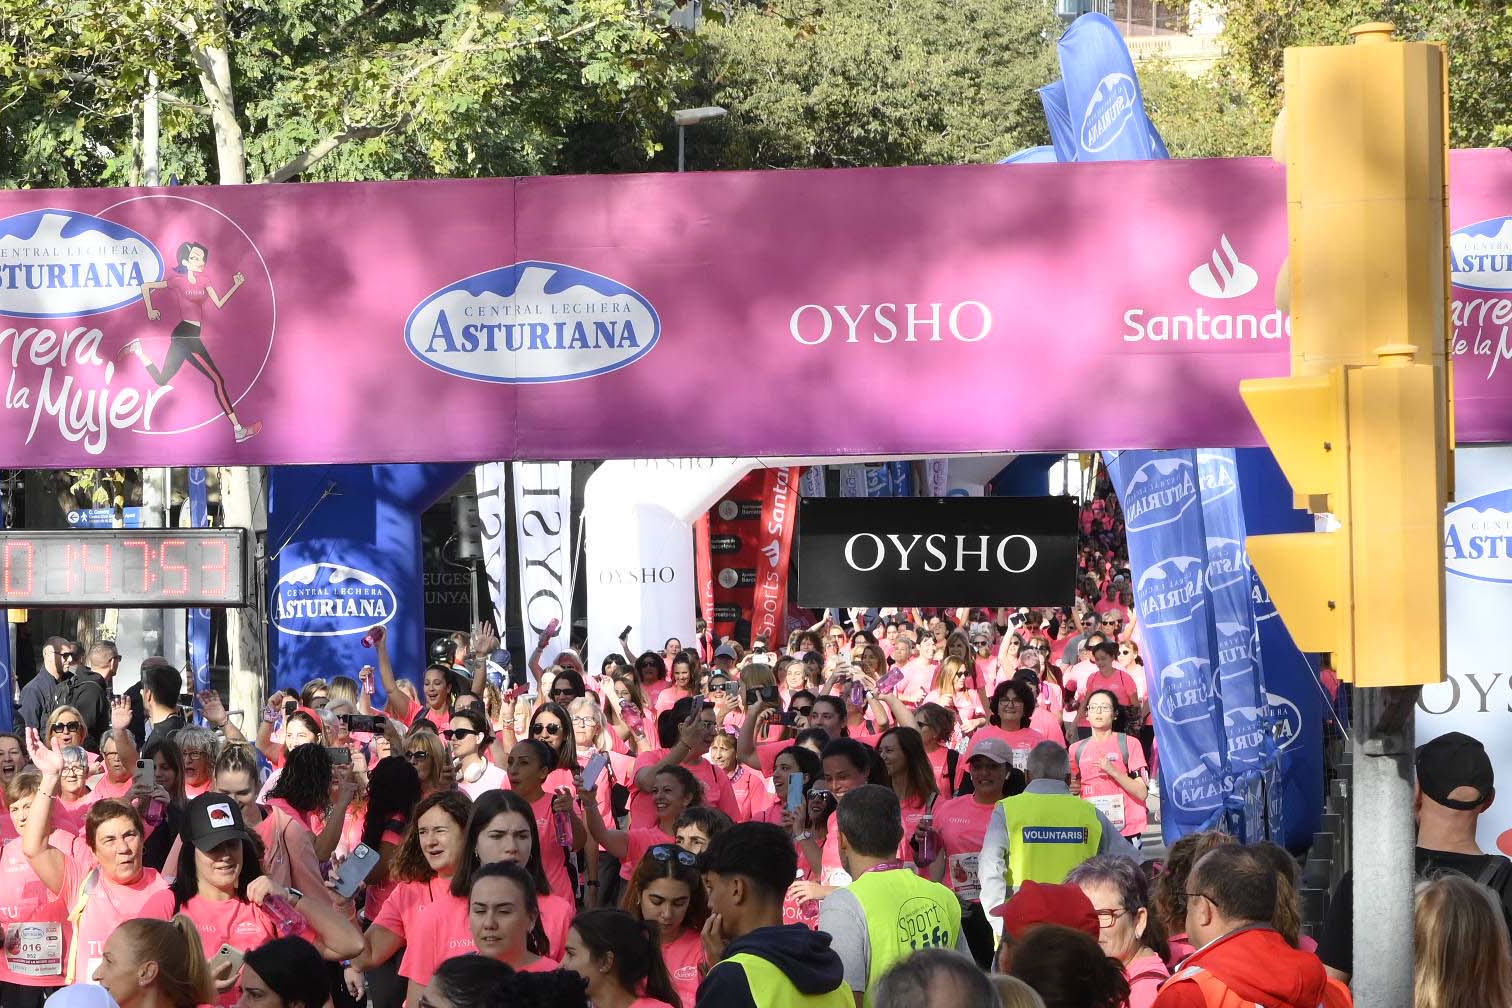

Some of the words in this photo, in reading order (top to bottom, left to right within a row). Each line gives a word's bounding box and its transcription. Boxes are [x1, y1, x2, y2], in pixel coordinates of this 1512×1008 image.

[464, 305, 543, 317] CENTRAL
[551, 302, 632, 315] LECHERA
[425, 309, 640, 353] ASTURIANA
[789, 301, 990, 345] OYSHO
[1474, 328, 1491, 356] la
[5, 368, 29, 409] la
[25, 363, 174, 454] Mujer
[844, 533, 1038, 573] OYSHO
[599, 566, 675, 584] OYSHO
[287, 588, 330, 597] CENTRAL
[334, 588, 383, 597] LECHERA
[275, 596, 388, 619] ASTURIANA
[1023, 828, 1083, 841] VOLUNTARIS
[0, 905, 18, 918] TU
[898, 904, 941, 943] Sport
[22, 944, 41, 952] 016
